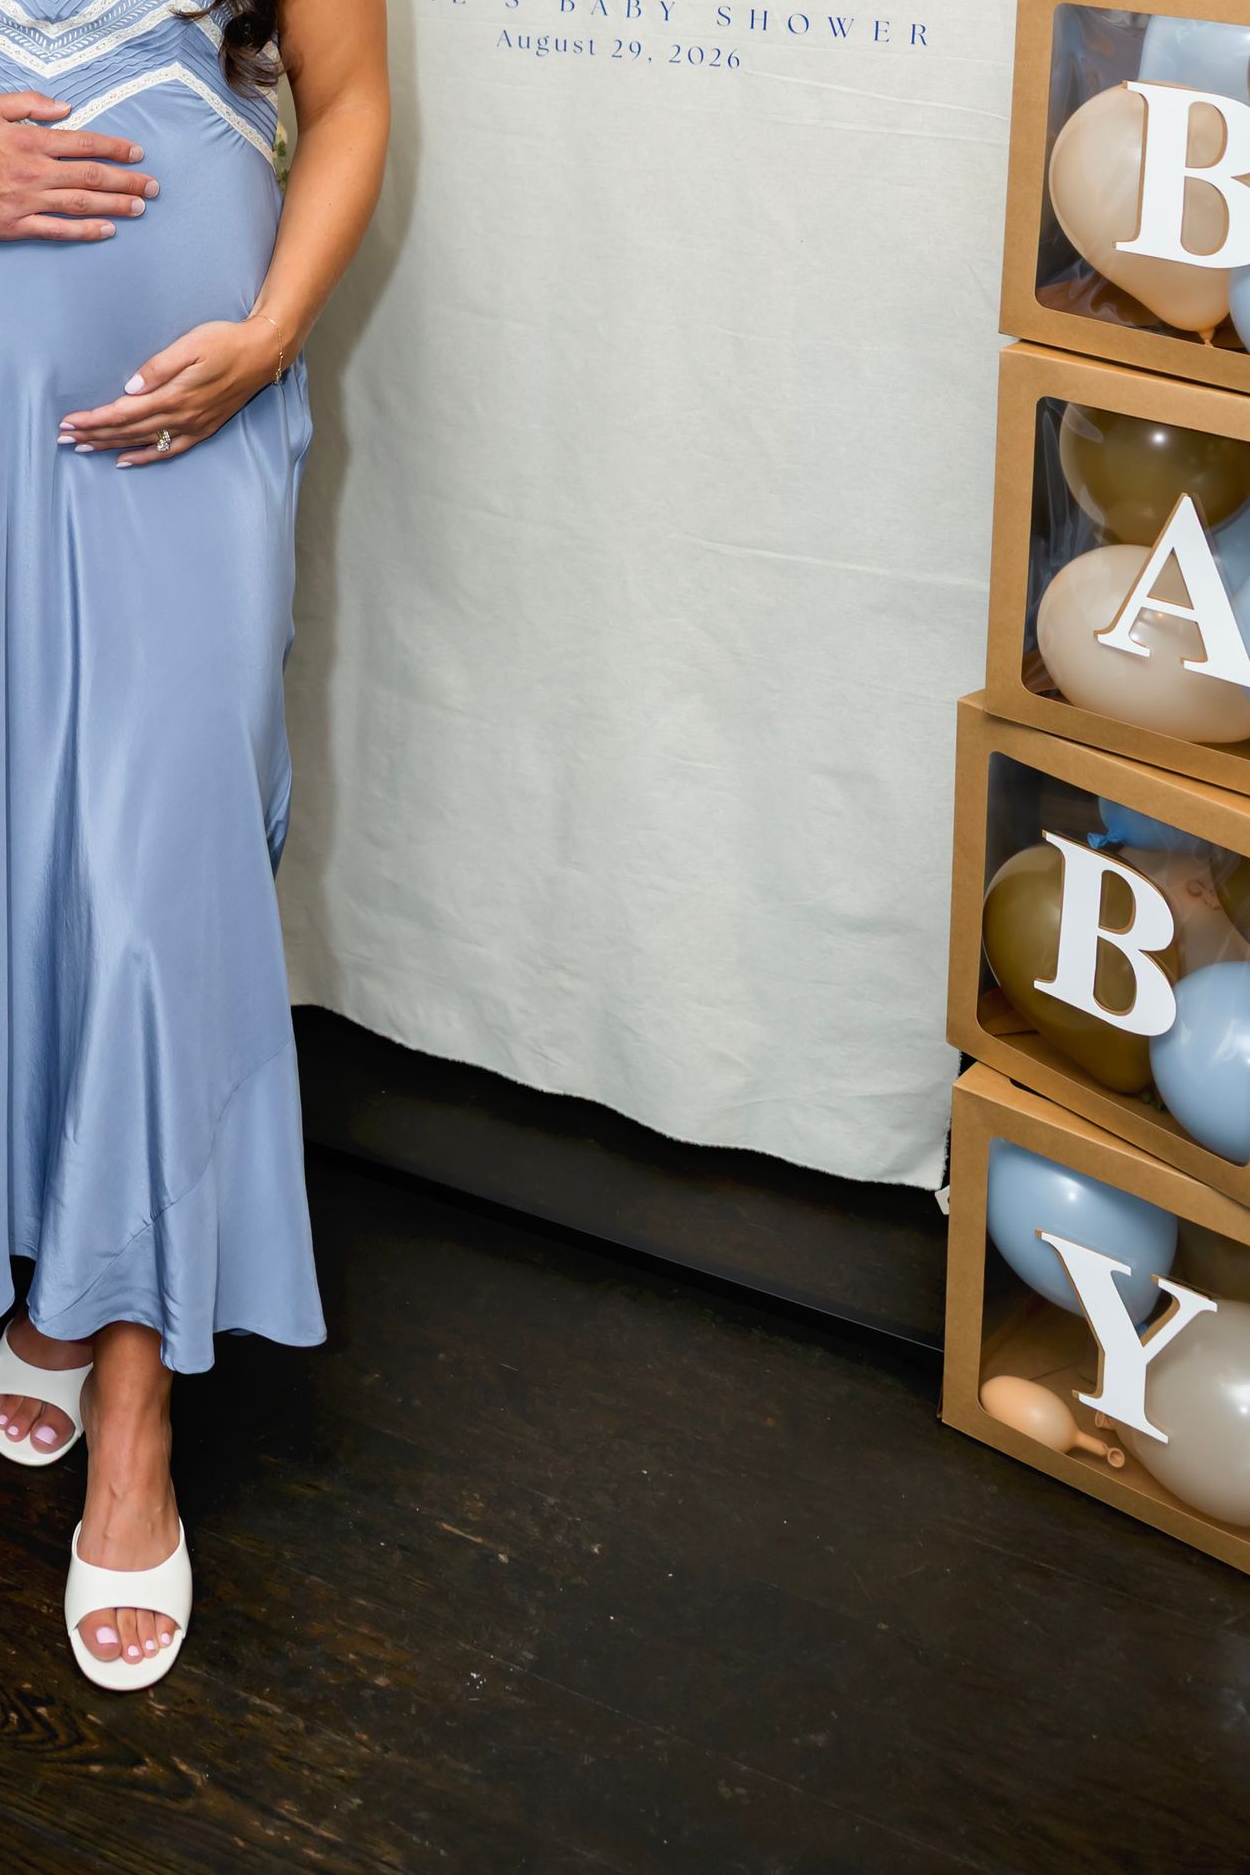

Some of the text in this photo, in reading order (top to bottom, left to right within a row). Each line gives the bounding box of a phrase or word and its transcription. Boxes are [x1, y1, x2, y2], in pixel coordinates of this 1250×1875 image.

[715, 4, 930, 48] SHOWER
[496, 28, 742, 70] August 29, 2026
